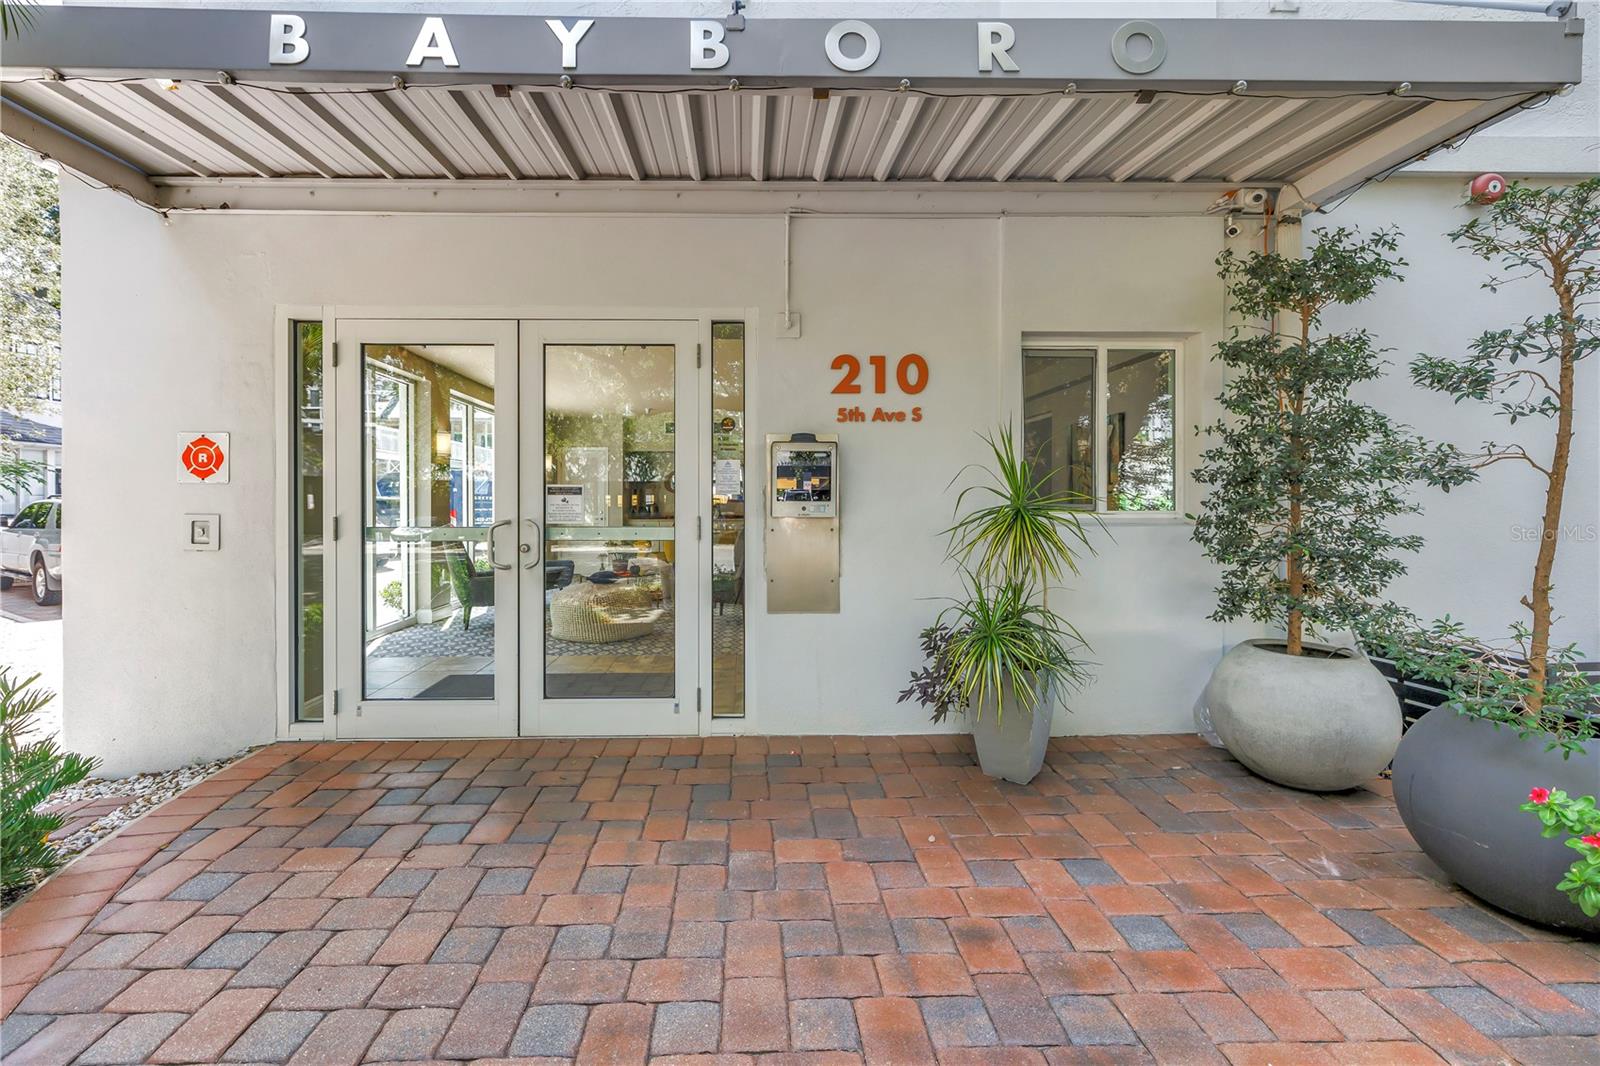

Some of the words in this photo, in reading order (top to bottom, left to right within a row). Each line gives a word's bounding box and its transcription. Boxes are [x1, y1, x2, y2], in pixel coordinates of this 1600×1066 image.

[268, 13, 1167, 75] BAYBORO
[830, 353, 929, 395] 210
[836, 406, 866, 422] 5th
[871, 407, 906, 422] Ave
[911, 406, 923, 422] S
[198, 453, 208, 463] R
